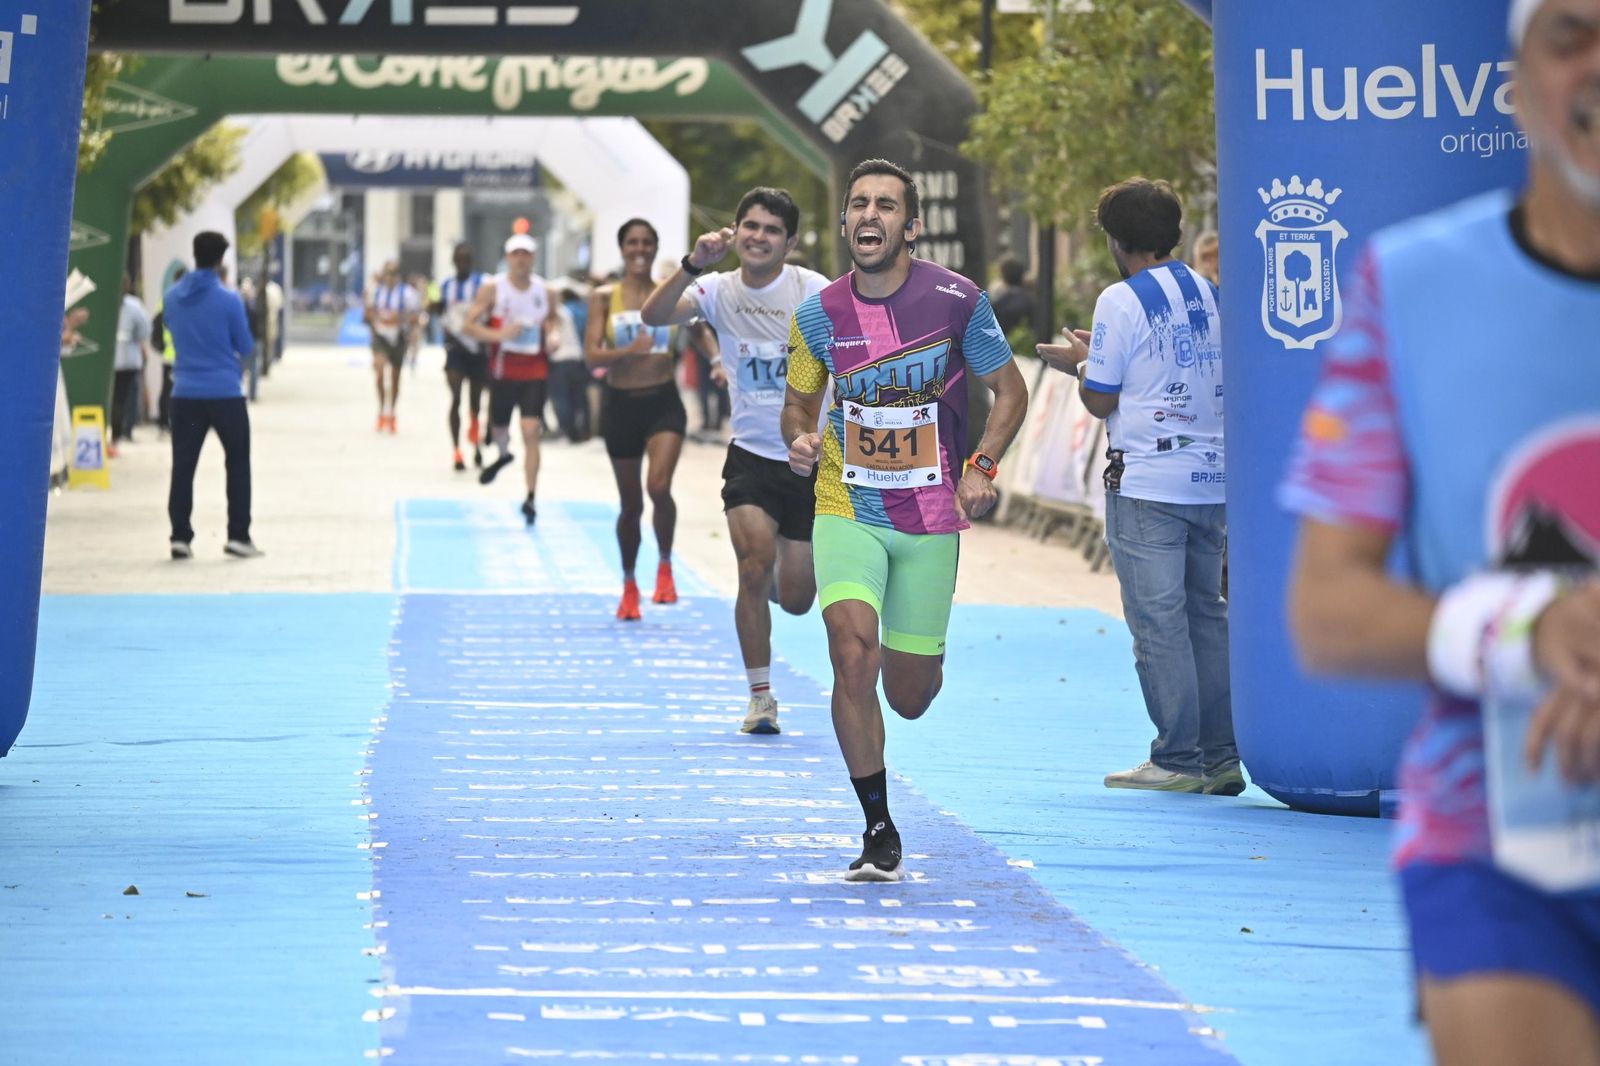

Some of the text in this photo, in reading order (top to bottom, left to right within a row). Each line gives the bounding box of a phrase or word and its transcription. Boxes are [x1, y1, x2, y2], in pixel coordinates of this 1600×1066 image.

[1440, 125, 1533, 158] origina
[1322, 258, 1331, 302] CUSTODIA
[78, 438, 101, 464] 21
[859, 427, 918, 459] 541
[867, 470, 909, 482] Huelva
